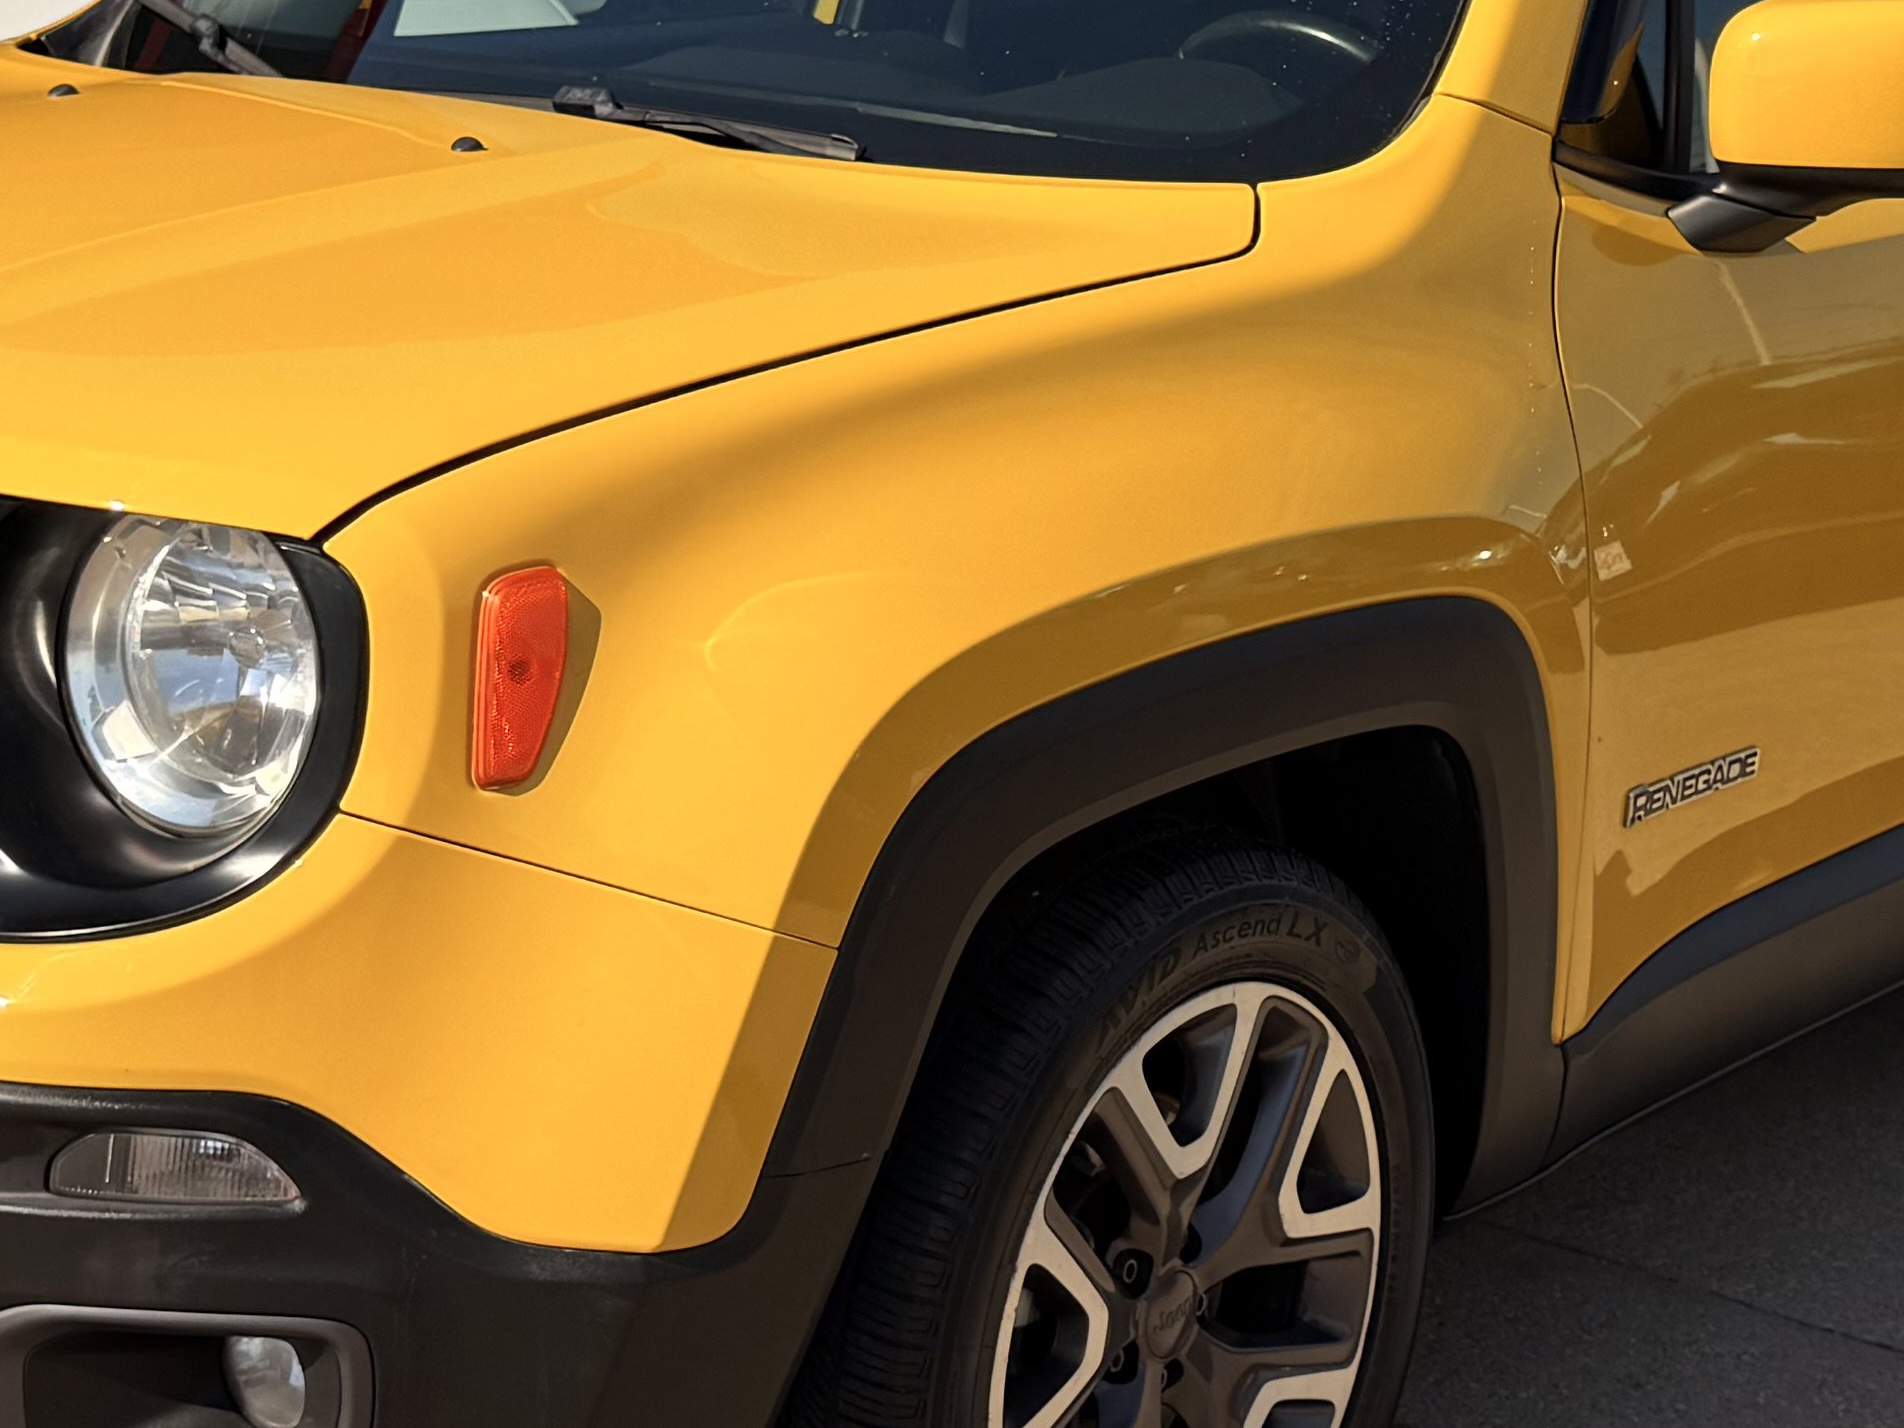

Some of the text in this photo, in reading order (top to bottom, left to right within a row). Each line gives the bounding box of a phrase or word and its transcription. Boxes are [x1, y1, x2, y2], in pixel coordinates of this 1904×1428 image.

[1623, 745, 1760, 828] RENEGADE
[1195, 915, 1280, 959] Ascend
[1287, 915, 1330, 948] LX
